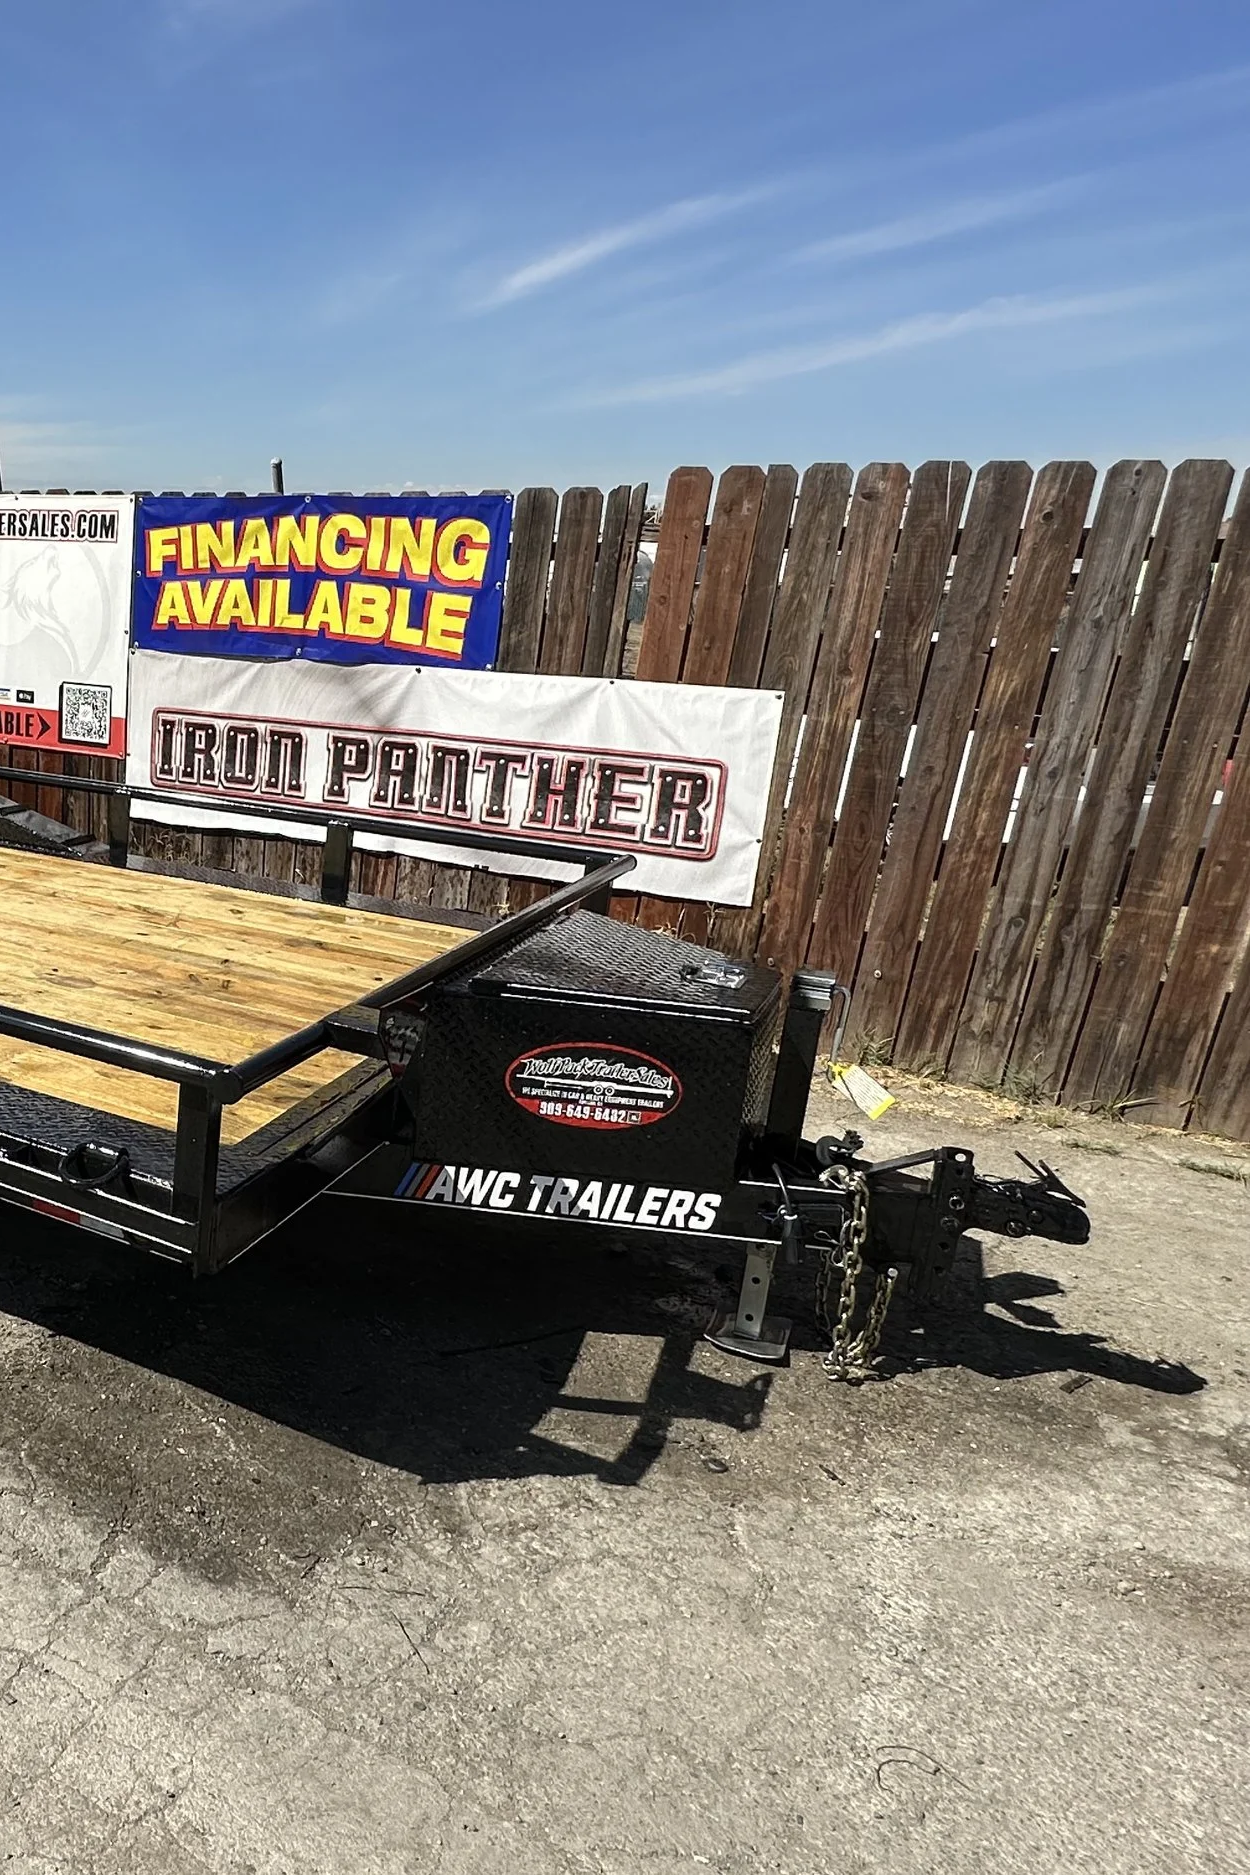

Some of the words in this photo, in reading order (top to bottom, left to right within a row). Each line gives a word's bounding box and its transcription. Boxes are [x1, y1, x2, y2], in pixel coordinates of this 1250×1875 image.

[146, 514, 491, 587] FINANCING
[152, 578, 472, 660] AVAILABLE
[156, 718, 305, 795] IRON
[326, 734, 717, 848] PANTHER
[425, 1165, 521, 1209] AWC
[527, 1174, 722, 1231] TRAILERS
